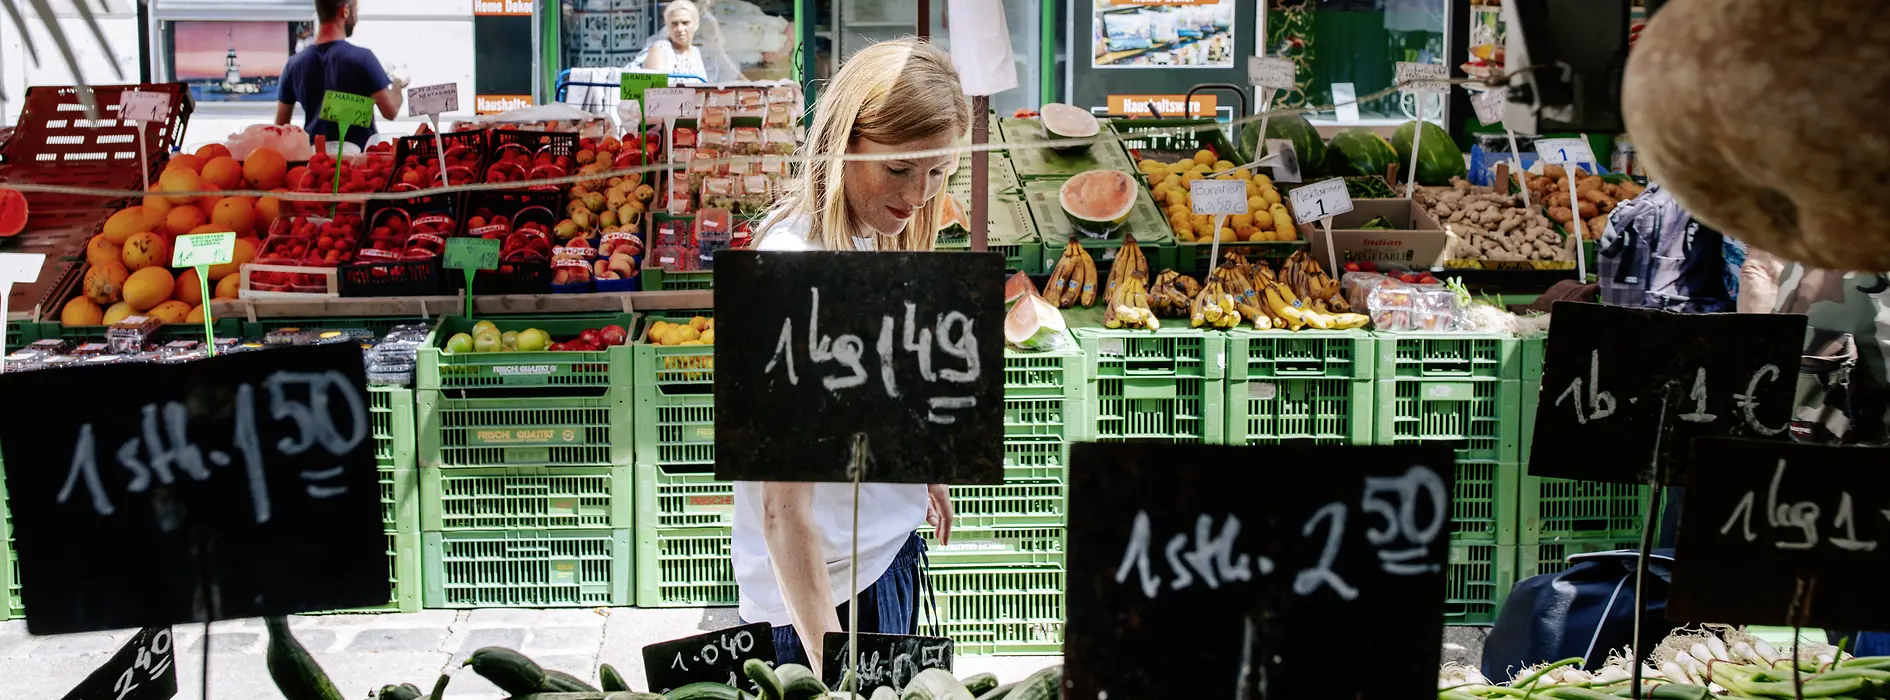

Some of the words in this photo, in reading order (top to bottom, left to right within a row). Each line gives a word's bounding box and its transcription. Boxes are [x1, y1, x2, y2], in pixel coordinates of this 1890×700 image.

[475, 0, 502, 12] Home
[1194, 181, 1243, 197] Bananen
[1316, 198, 1330, 217] 1
[764, 317, 799, 386] 1
[808, 286, 868, 391] kg
[1732, 363, 1790, 437] €
[1720, 490, 1757, 542] 1
[1767, 458, 1820, 549] kg
